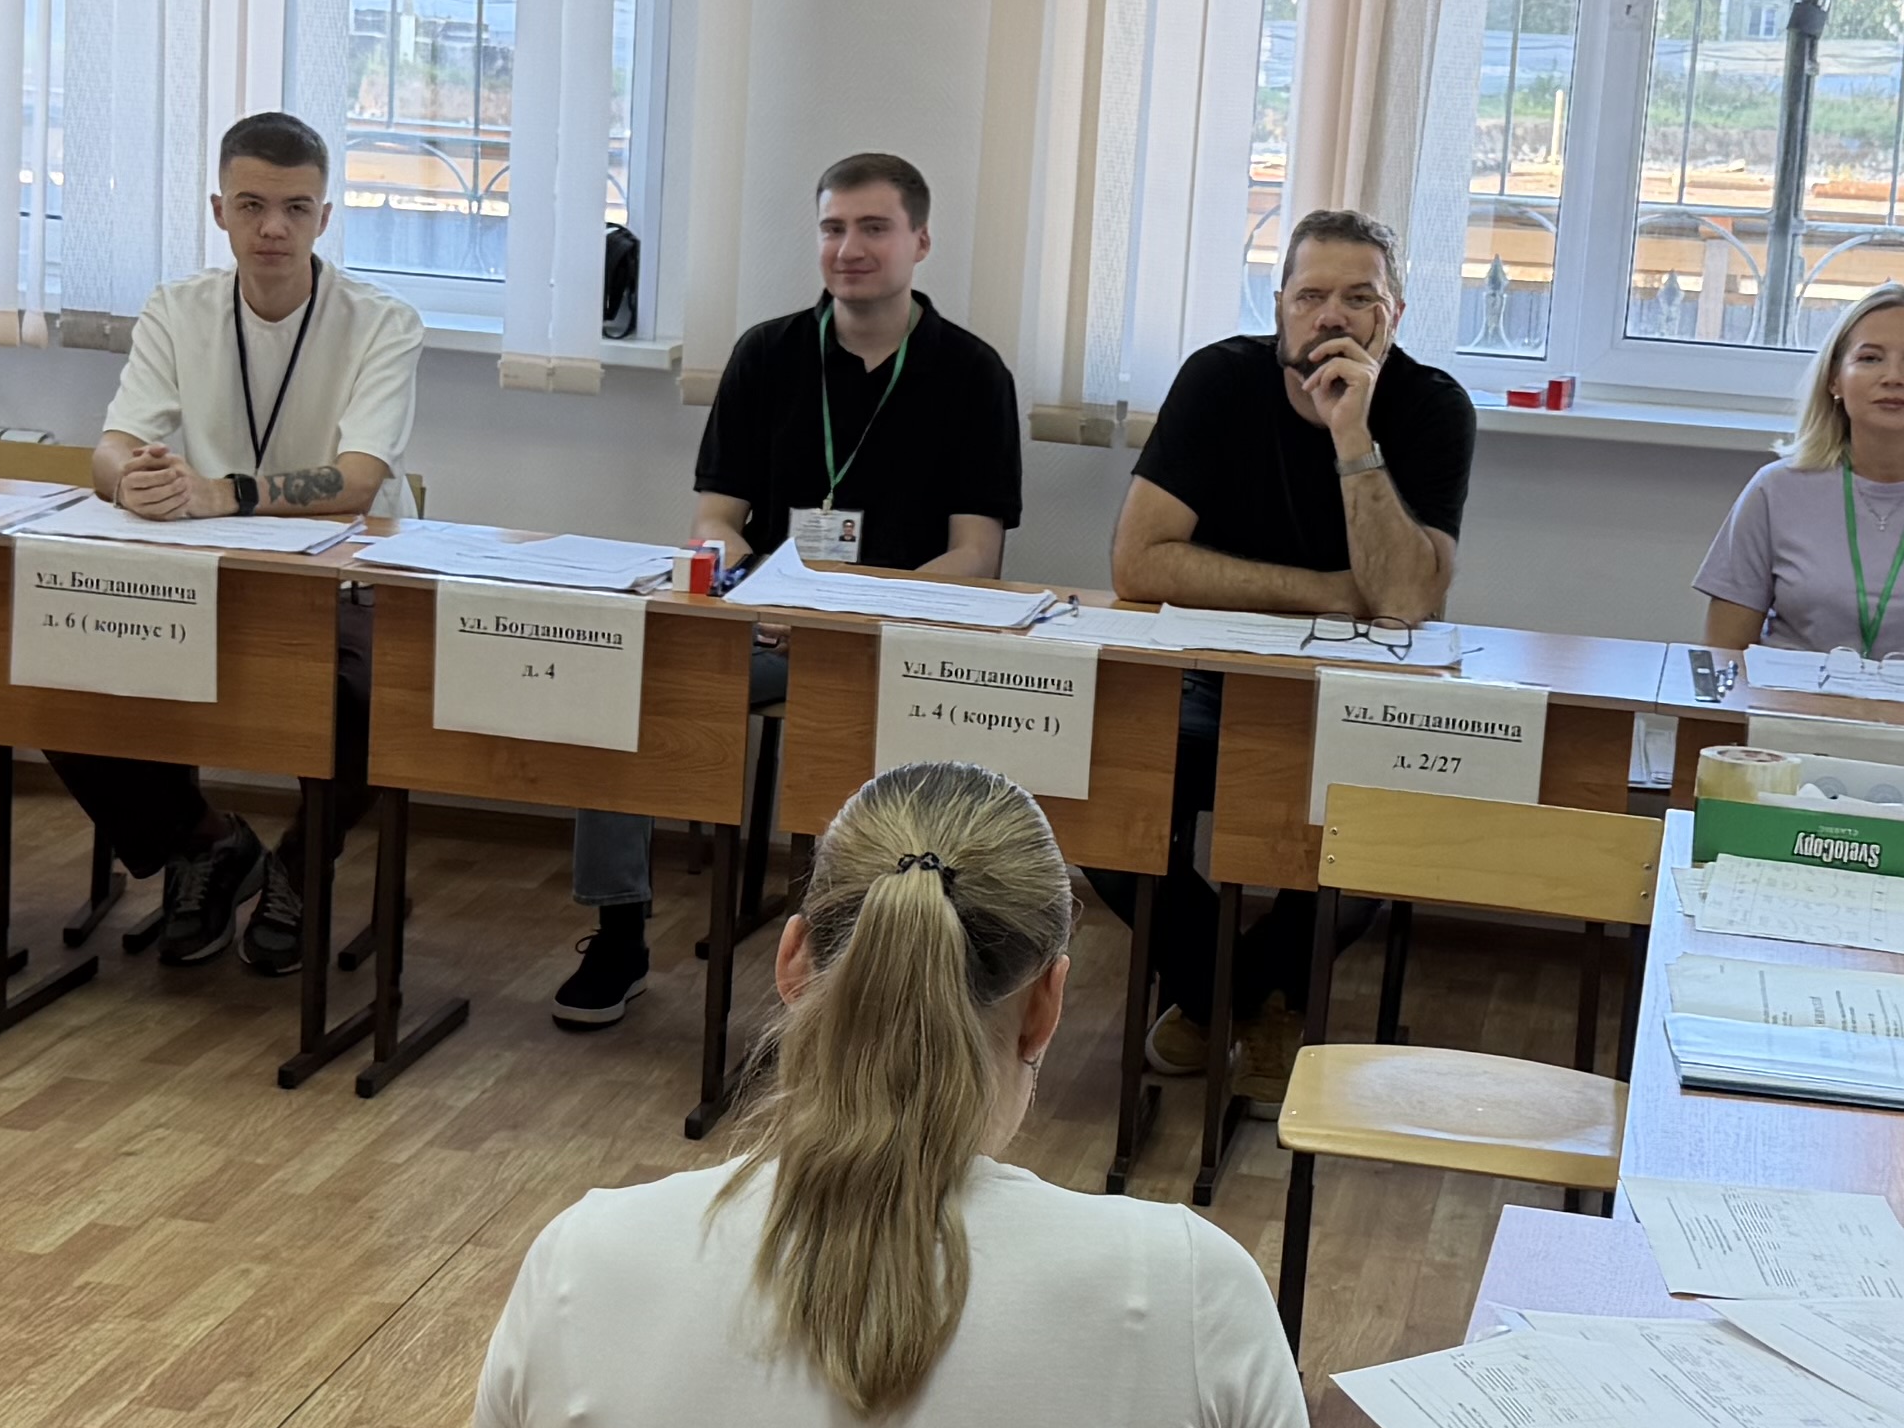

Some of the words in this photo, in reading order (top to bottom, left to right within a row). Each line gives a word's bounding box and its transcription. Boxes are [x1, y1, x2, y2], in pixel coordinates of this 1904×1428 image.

[36, 571, 64, 586] ул.
[71, 571, 196, 600] Богдановича
[42, 613, 59, 627] д.
[65, 612, 76, 629] 6
[94, 618, 163, 640] корпус
[170, 623, 187, 644] 1)
[459, 616, 488, 630] ул.
[495, 615, 623, 645] Богдановича
[521, 664, 539, 678] д.
[544, 663, 556, 679] 4
[904, 660, 932, 676] ул.
[940, 660, 1074, 692] Богдановича
[908, 704, 927, 717] д.
[931, 703, 943, 720] 4
[963, 710, 1036, 733] корпус
[1043, 716, 1061, 737] 1)
[1344, 704, 1374, 720] ул.
[1382, 704, 1523, 738] Богдановича
[1392, 755, 1411, 769] д.
[1418, 753, 1462, 774] 2/27
[1793, 832, 1881, 868] SvetoCopy
